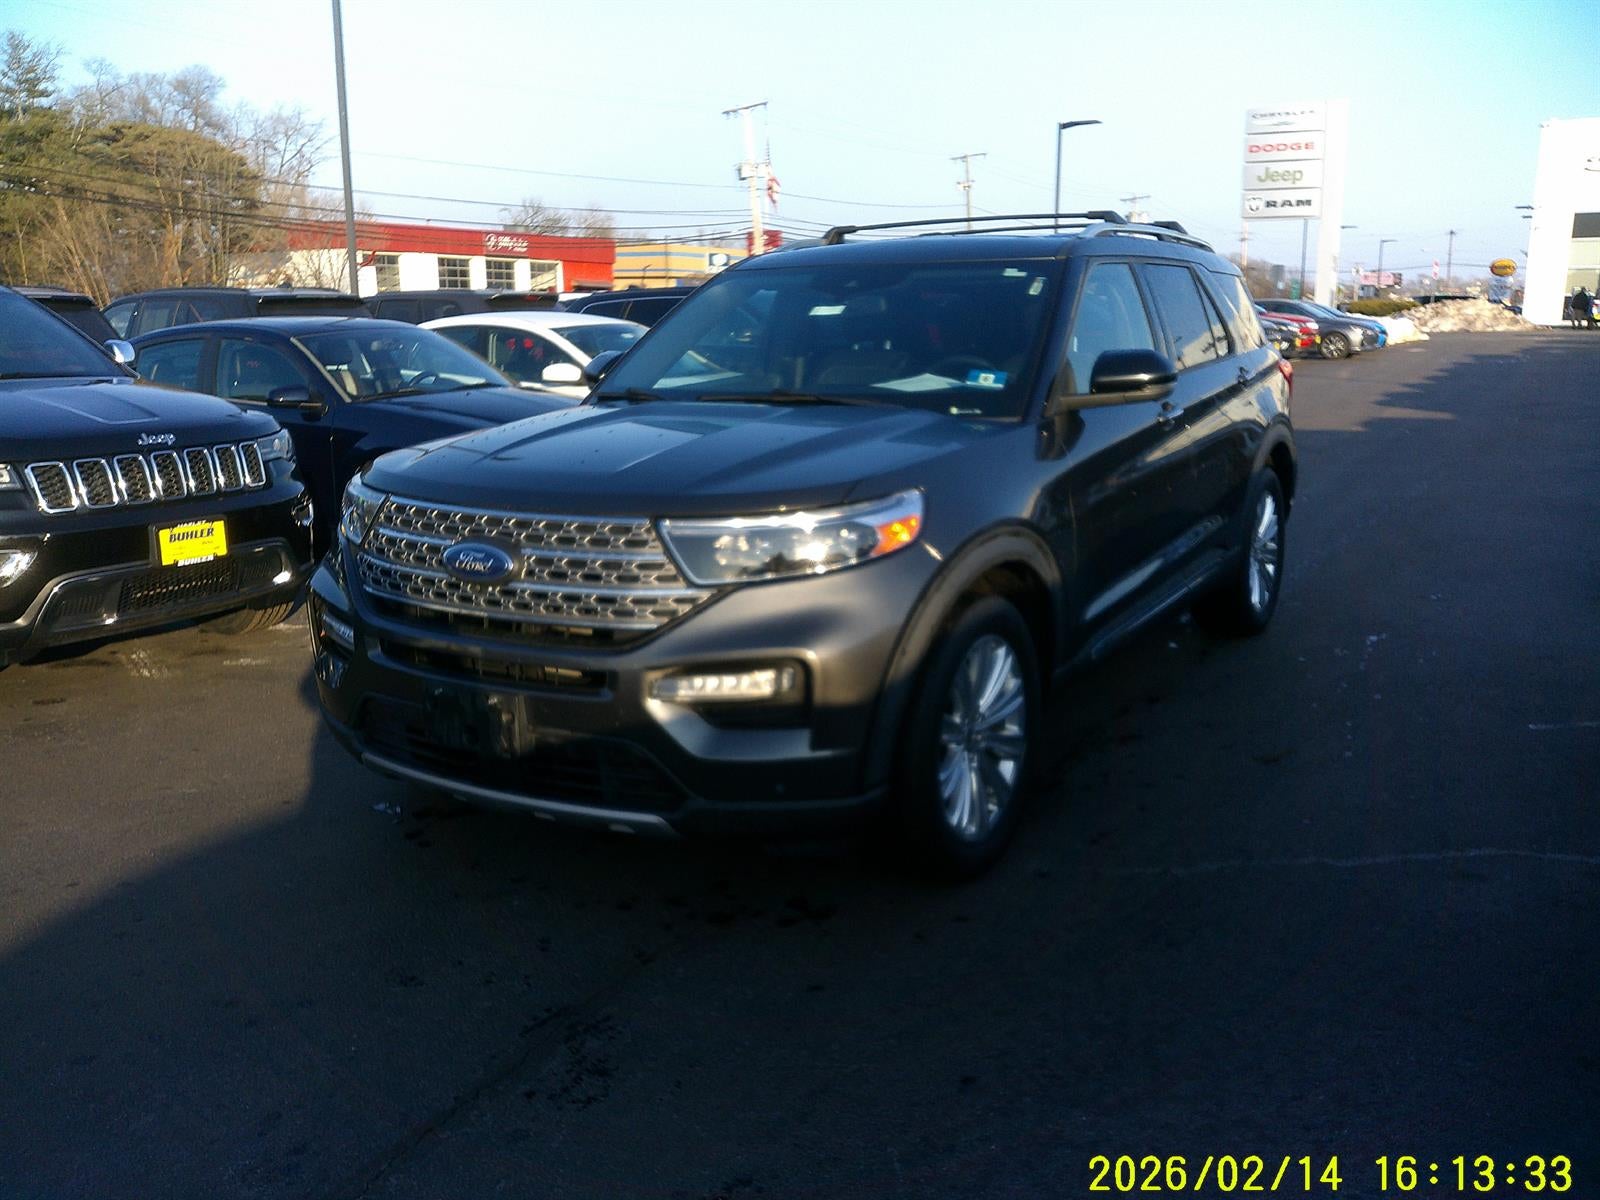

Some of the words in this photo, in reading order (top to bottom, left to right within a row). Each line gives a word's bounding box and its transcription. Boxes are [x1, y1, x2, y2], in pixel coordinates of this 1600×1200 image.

[1248, 141, 1315, 154] DODGE
[1257, 166, 1304, 184] Jeep
[1264, 199, 1312, 209] RAM
[137, 433, 176, 446] Jeep
[169, 527, 214, 544] BUHLER
[455, 551, 494, 573] Ford
